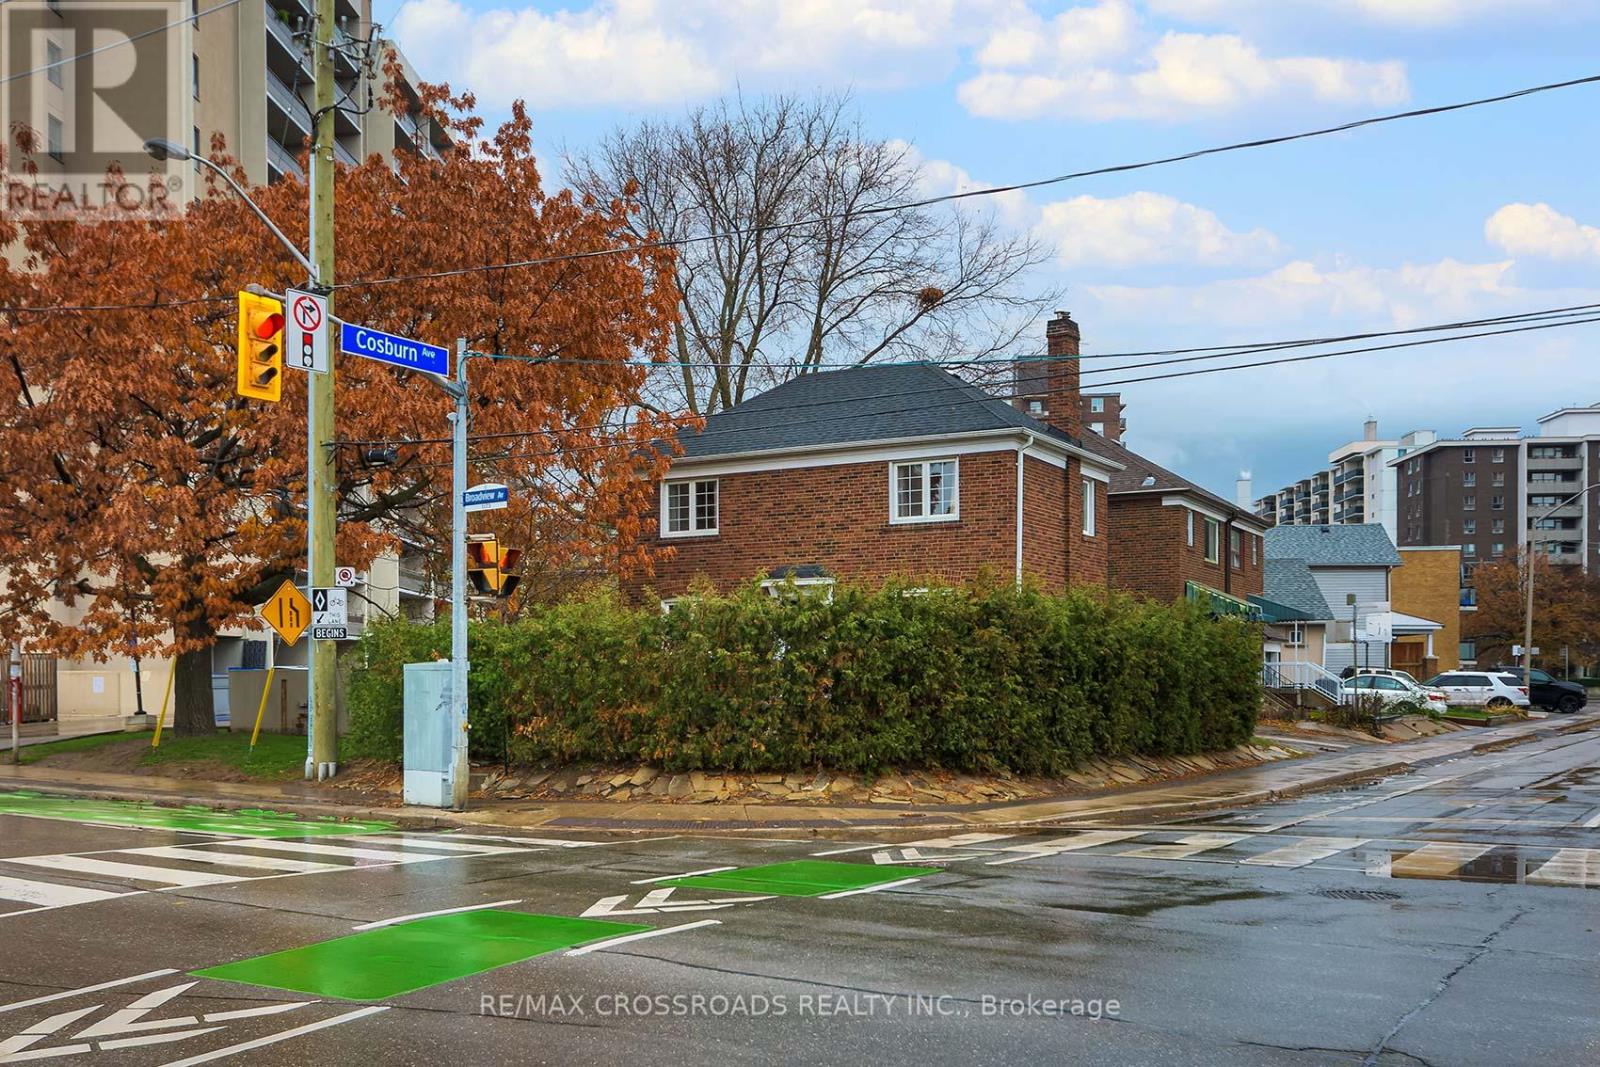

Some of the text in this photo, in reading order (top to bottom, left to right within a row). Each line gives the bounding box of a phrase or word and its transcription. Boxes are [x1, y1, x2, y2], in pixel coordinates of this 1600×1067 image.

[356, 330, 436, 362] Cosburn Ave
[316, 628, 345, 638] BEGINS
